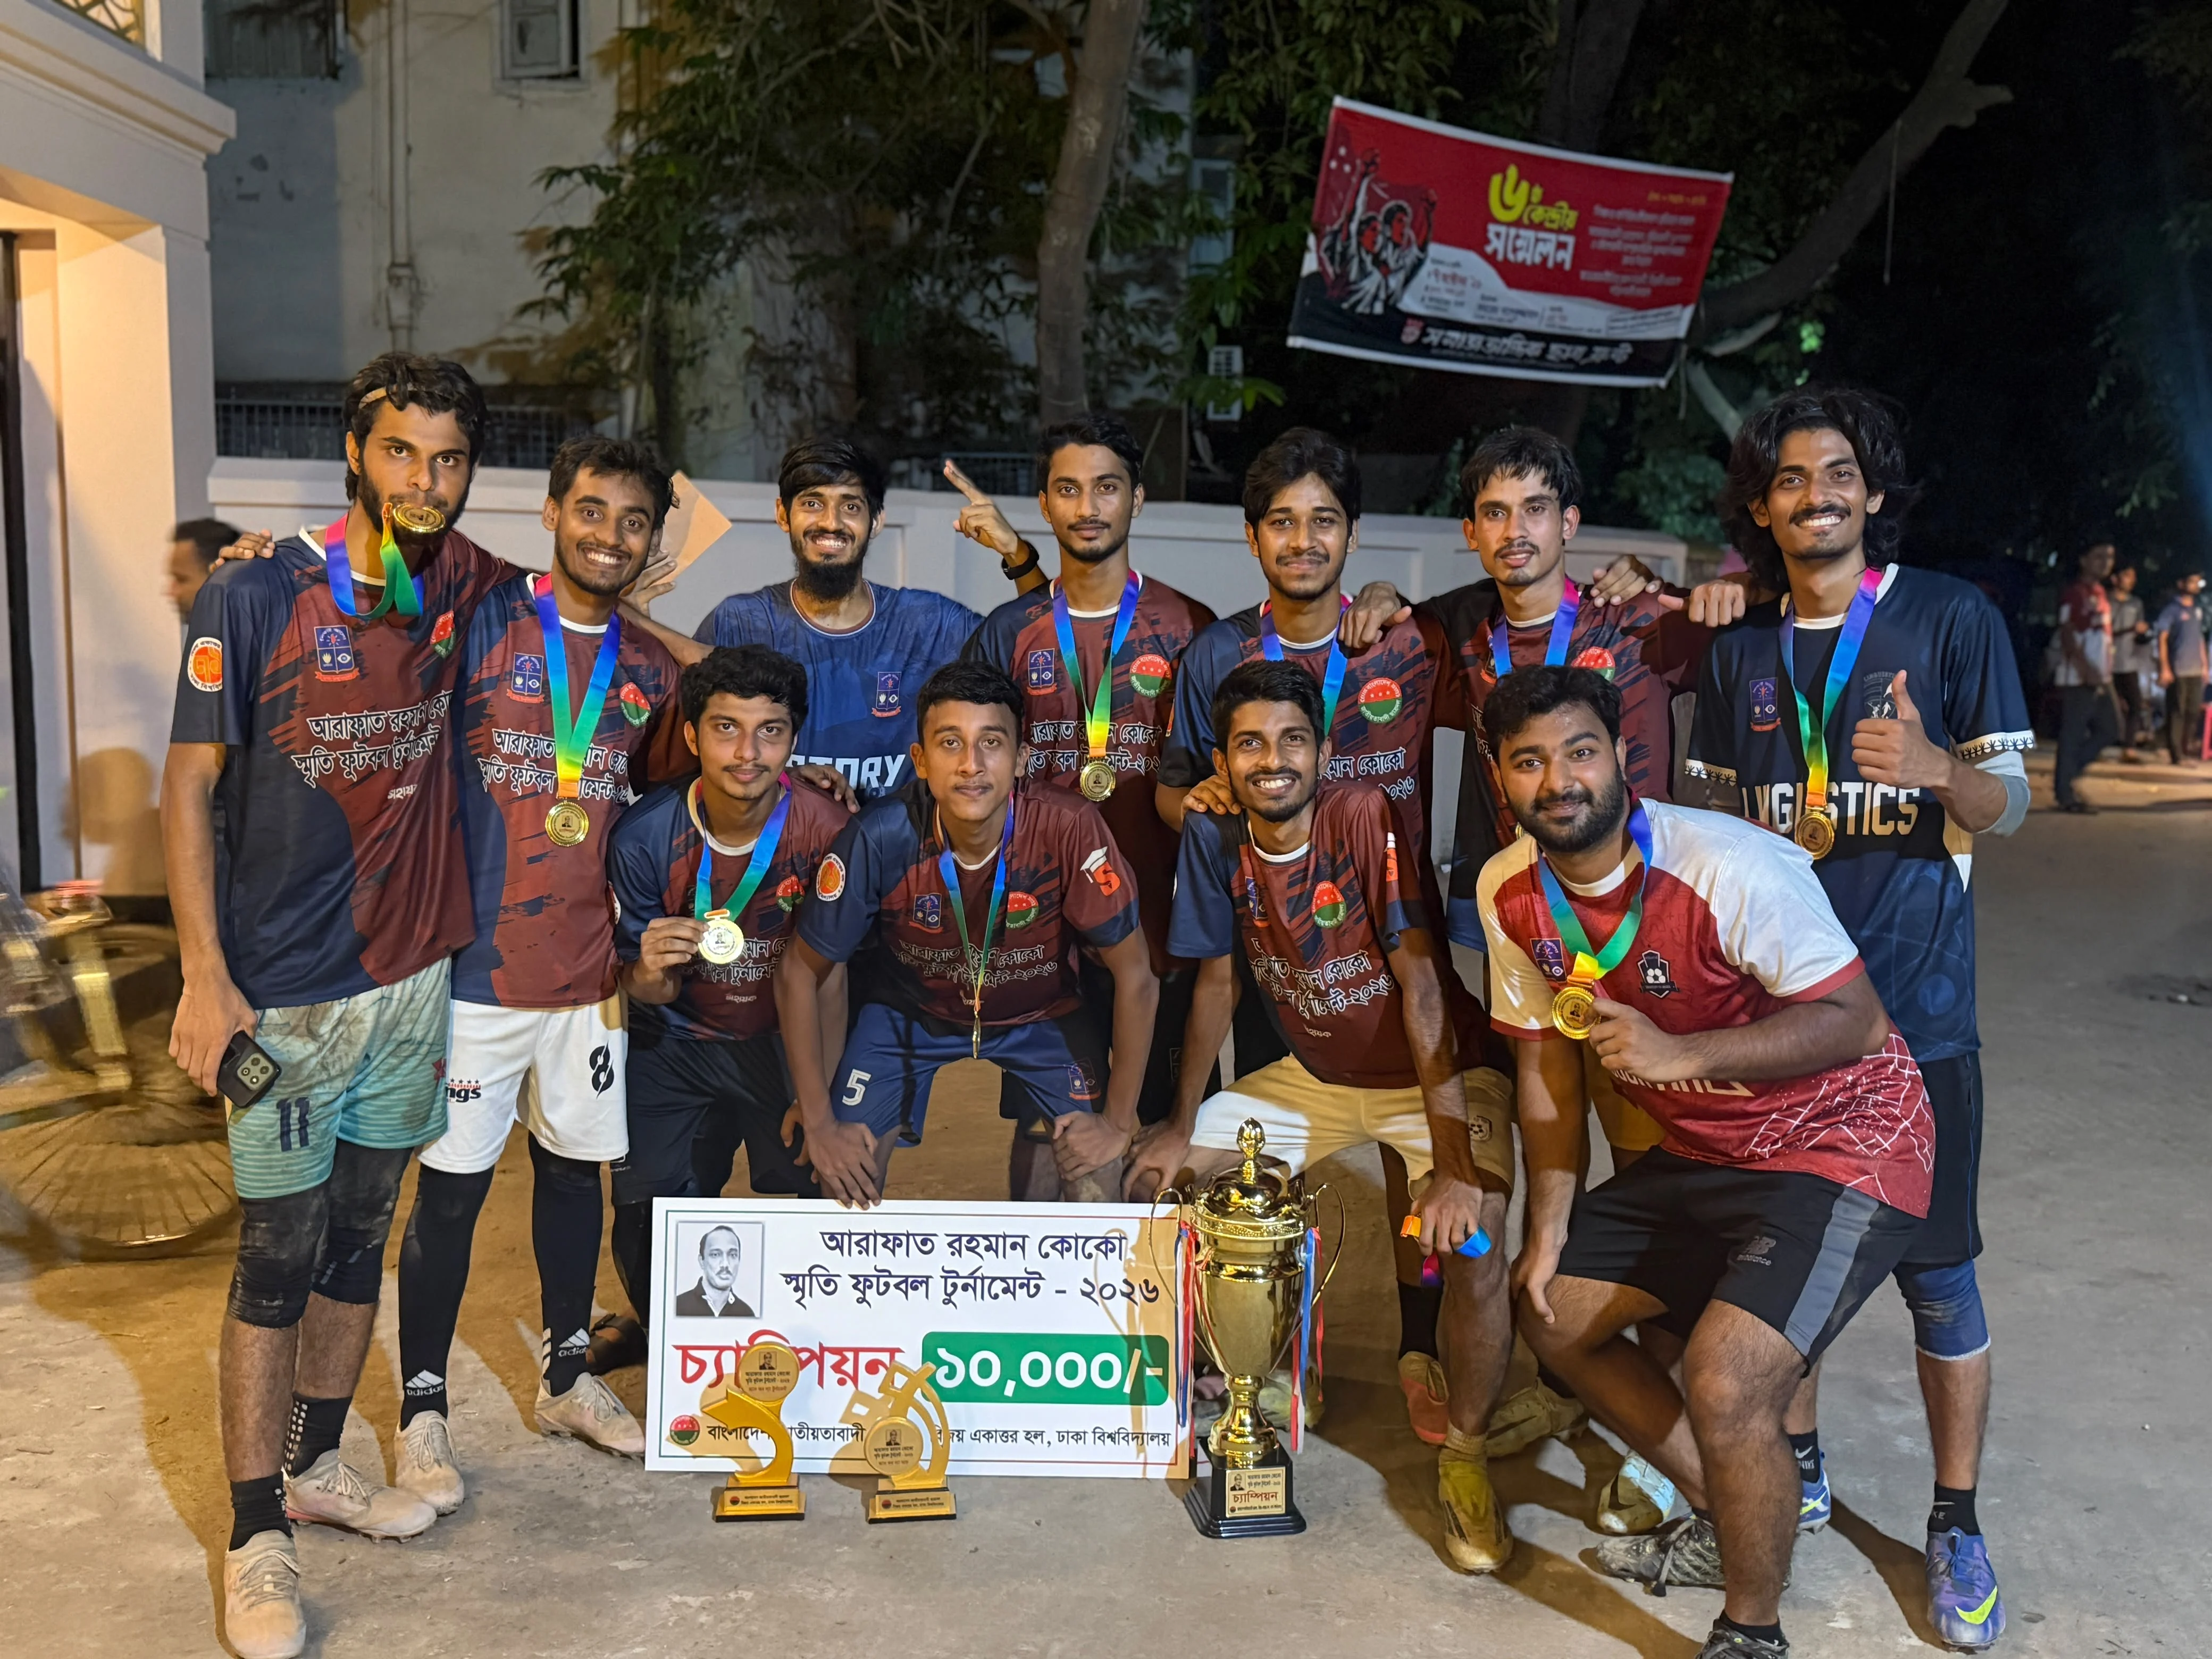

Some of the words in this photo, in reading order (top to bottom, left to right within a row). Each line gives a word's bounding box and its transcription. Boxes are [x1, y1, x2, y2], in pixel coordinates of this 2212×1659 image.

[306, 710, 387, 741] আরাফাত
[492, 728, 556, 758] আরাফাত
[291, 745, 336, 789] স্মৃতি
[337, 742, 391, 782] ফুটবল
[509, 759, 557, 796] ফুটবল
[1317, 755, 1355, 780] মান
[1357, 747, 1406, 775] কোকো
[998, 944, 1044, 968] কোকো
[1323, 949, 1372, 984] কোকো
[589, 1042, 615, 1097] 8
[842, 1068, 872, 1106] 5
[445, 1086, 482, 1103] ngs
[275, 1097, 310, 1152] 11
[819, 1229, 939, 1258] আরাফাত
[944, 1231, 1029, 1261] রহমান
[1037, 1232, 1128, 1261] কোকো
[779, 1264, 842, 1310] স্মৃতি
[848, 1265, 934, 1308] ফুটবল
[940, 1265, 1046, 1309] টুর্নামেন্ট
[1079, 1277, 1160, 1306] ২০২৬
[935, 1347, 1163, 1397] ১০,০০০/-
[787, 1421, 867, 1443] াতীয়তাবাদী
[969, 1428, 1019, 1444] একাত্তর
[1024, 1429, 1051, 1448] হল,
[1057, 1428, 1088, 1445] ঢাকা
[1093, 1426, 1171, 1447] বিশ্ববিদ্যালয়
